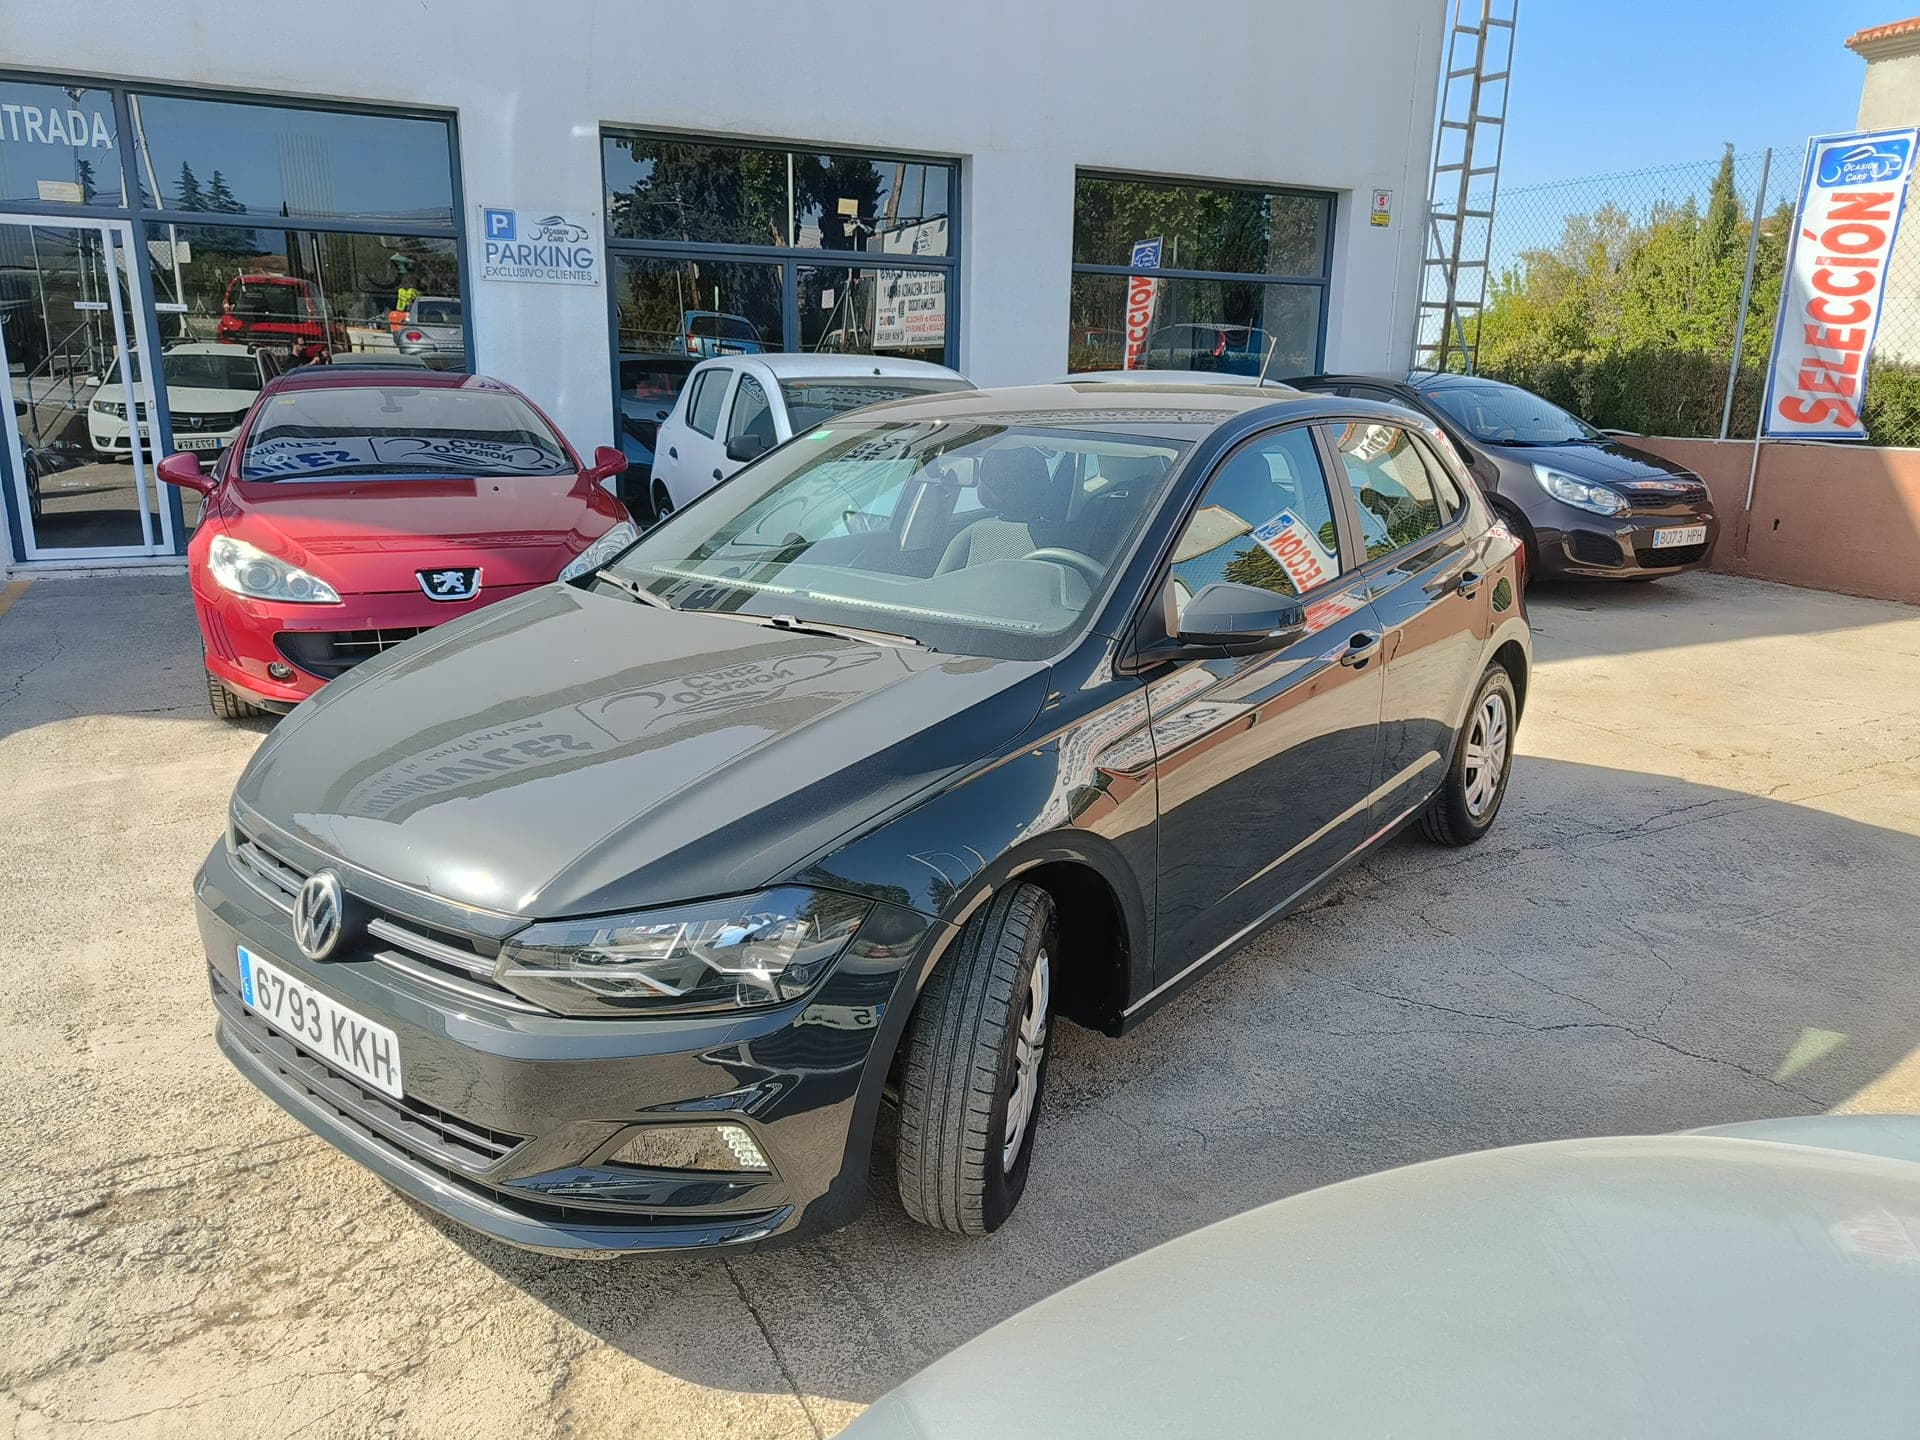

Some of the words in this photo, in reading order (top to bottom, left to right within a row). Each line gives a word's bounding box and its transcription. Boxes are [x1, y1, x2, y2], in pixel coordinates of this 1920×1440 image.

[491, 214, 508, 235] P
[485, 243, 593, 268] PARKING
[485, 266, 543, 278] EXCLUSIVO
[547, 269, 592, 280] CLIENTES
[1778, 192, 1895, 429] SELECCIÓN
[1660, 529, 1683, 545] 8073
[1686, 528, 1703, 543] HPH
[256, 966, 323, 1044] 6793
[330, 1010, 393, 1086] KKH
